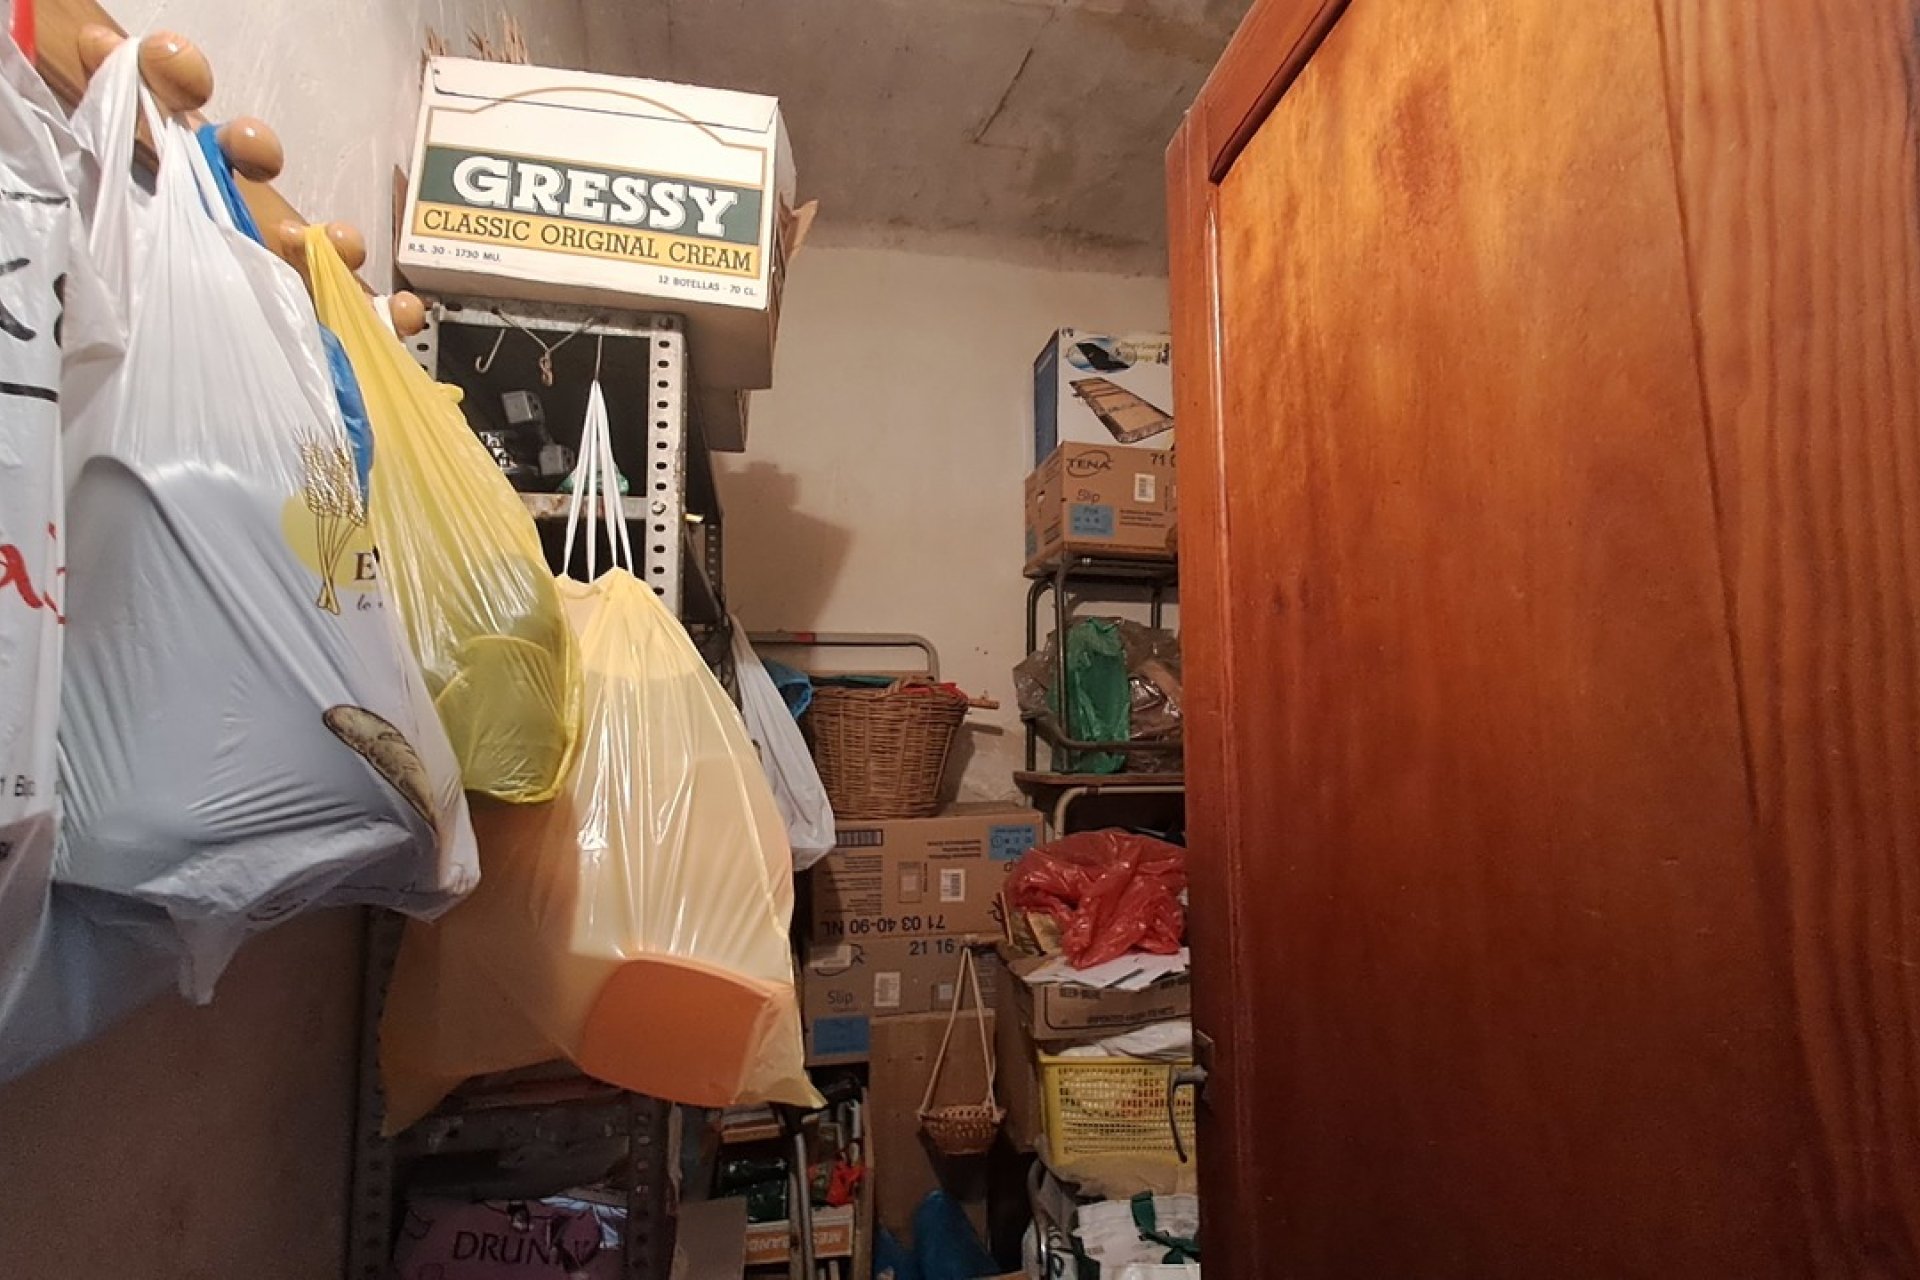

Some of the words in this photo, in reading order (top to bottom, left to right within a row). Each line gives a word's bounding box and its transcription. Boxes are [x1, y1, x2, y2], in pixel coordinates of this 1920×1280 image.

[453, 156, 738, 237] GRESSY
[423, 209, 530, 241] CLASSIC
[540, 224, 659, 259] ORIGINAL
[669, 241, 752, 272] CREAM
[658, 274, 670, 285] 12
[673, 277, 720, 291] BOTELLAS
[730, 284, 742, 294] 70
[1066, 457, 1114, 471] TENA
[823, 921, 844, 936] NL
[850, 918, 898, 934] 40-90
[901, 916, 921, 931] 03
[928, 915, 946, 930] 71
[909, 941, 928, 956] 21
[937, 938, 955, 953] 16
